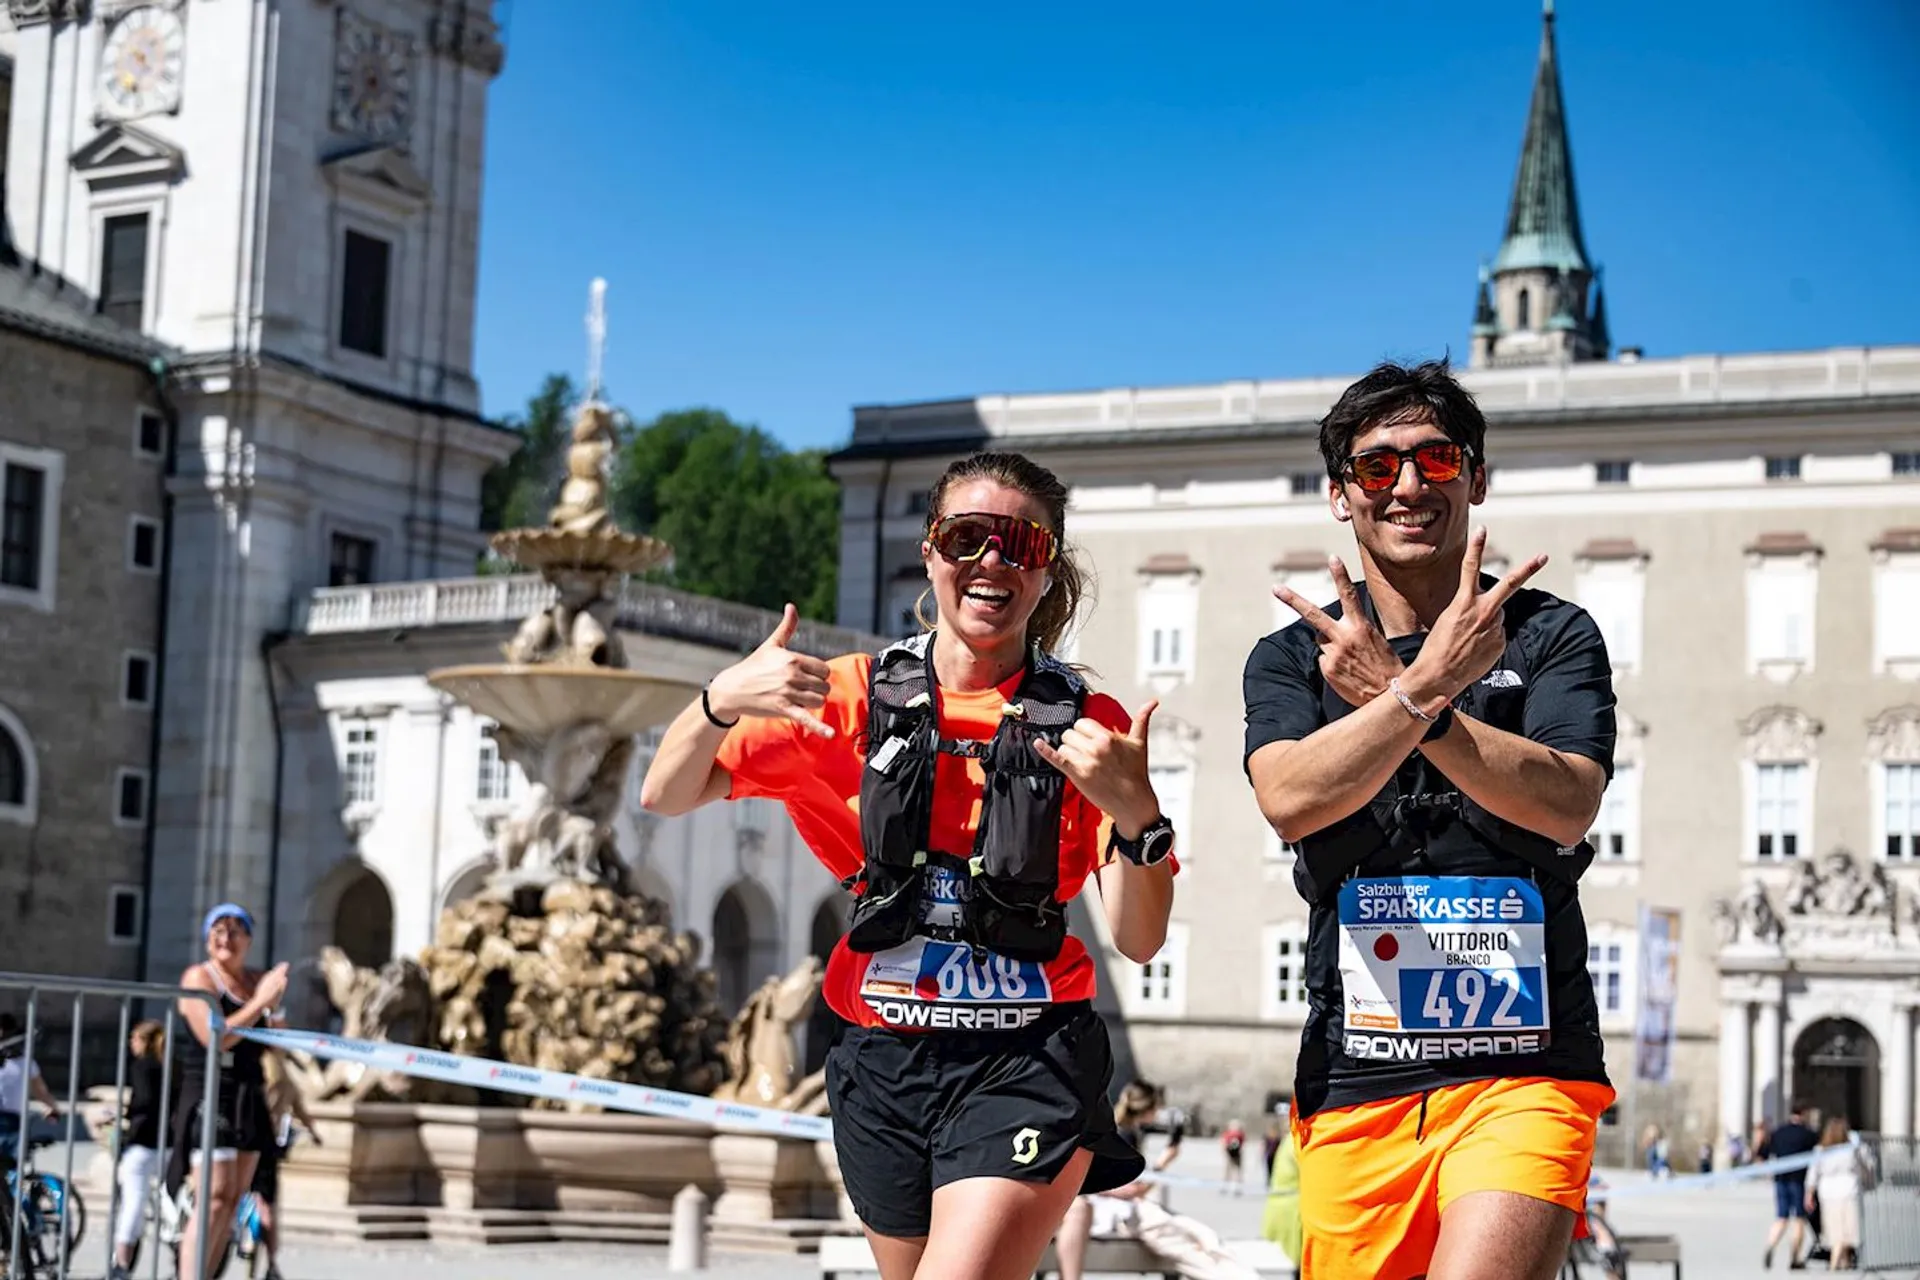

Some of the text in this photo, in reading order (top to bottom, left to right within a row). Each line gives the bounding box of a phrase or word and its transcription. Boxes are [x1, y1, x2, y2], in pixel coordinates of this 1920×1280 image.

[1357, 883, 1430, 898] Salzburger
[1358, 897, 1496, 919] SPARKASSE
[1428, 932, 1508, 951] VITTORIO
[1446, 953, 1491, 966] BRANCO
[937, 946, 1027, 999] 608
[1422, 969, 1522, 1028] 492
[865, 1000, 1043, 1030] POWERADE
[1345, 1034, 1542, 1060] POWERADE
